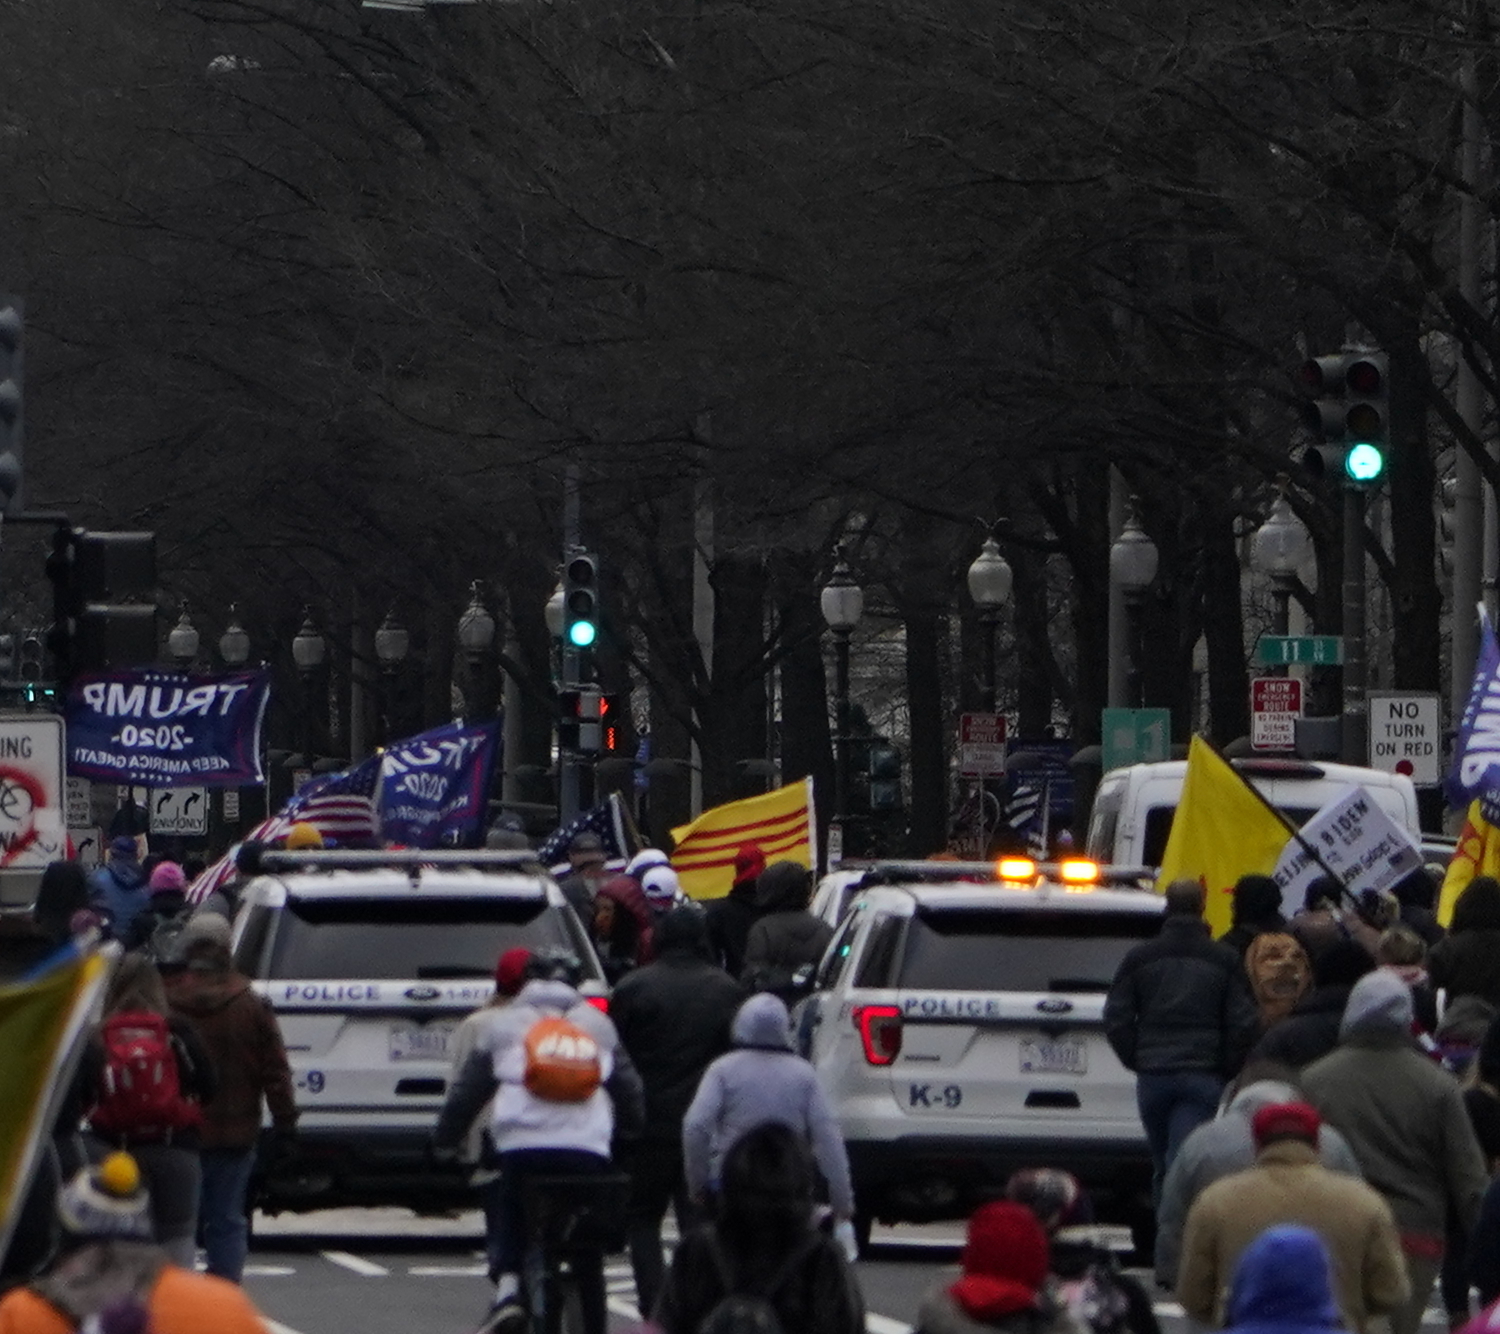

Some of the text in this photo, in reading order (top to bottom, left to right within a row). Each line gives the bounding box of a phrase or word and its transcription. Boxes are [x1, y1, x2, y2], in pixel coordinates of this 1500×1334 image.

[1388, 702, 1419, 719] NO
[1385, 724, 1425, 738] TURN
[1375, 742, 1433, 756] ON RED
[284, 985, 381, 1001] POLICE
[904, 998, 999, 1017] POLICE
[297, 1071, 326, 1094] -9
[909, 1083, 963, 1108] K-9
